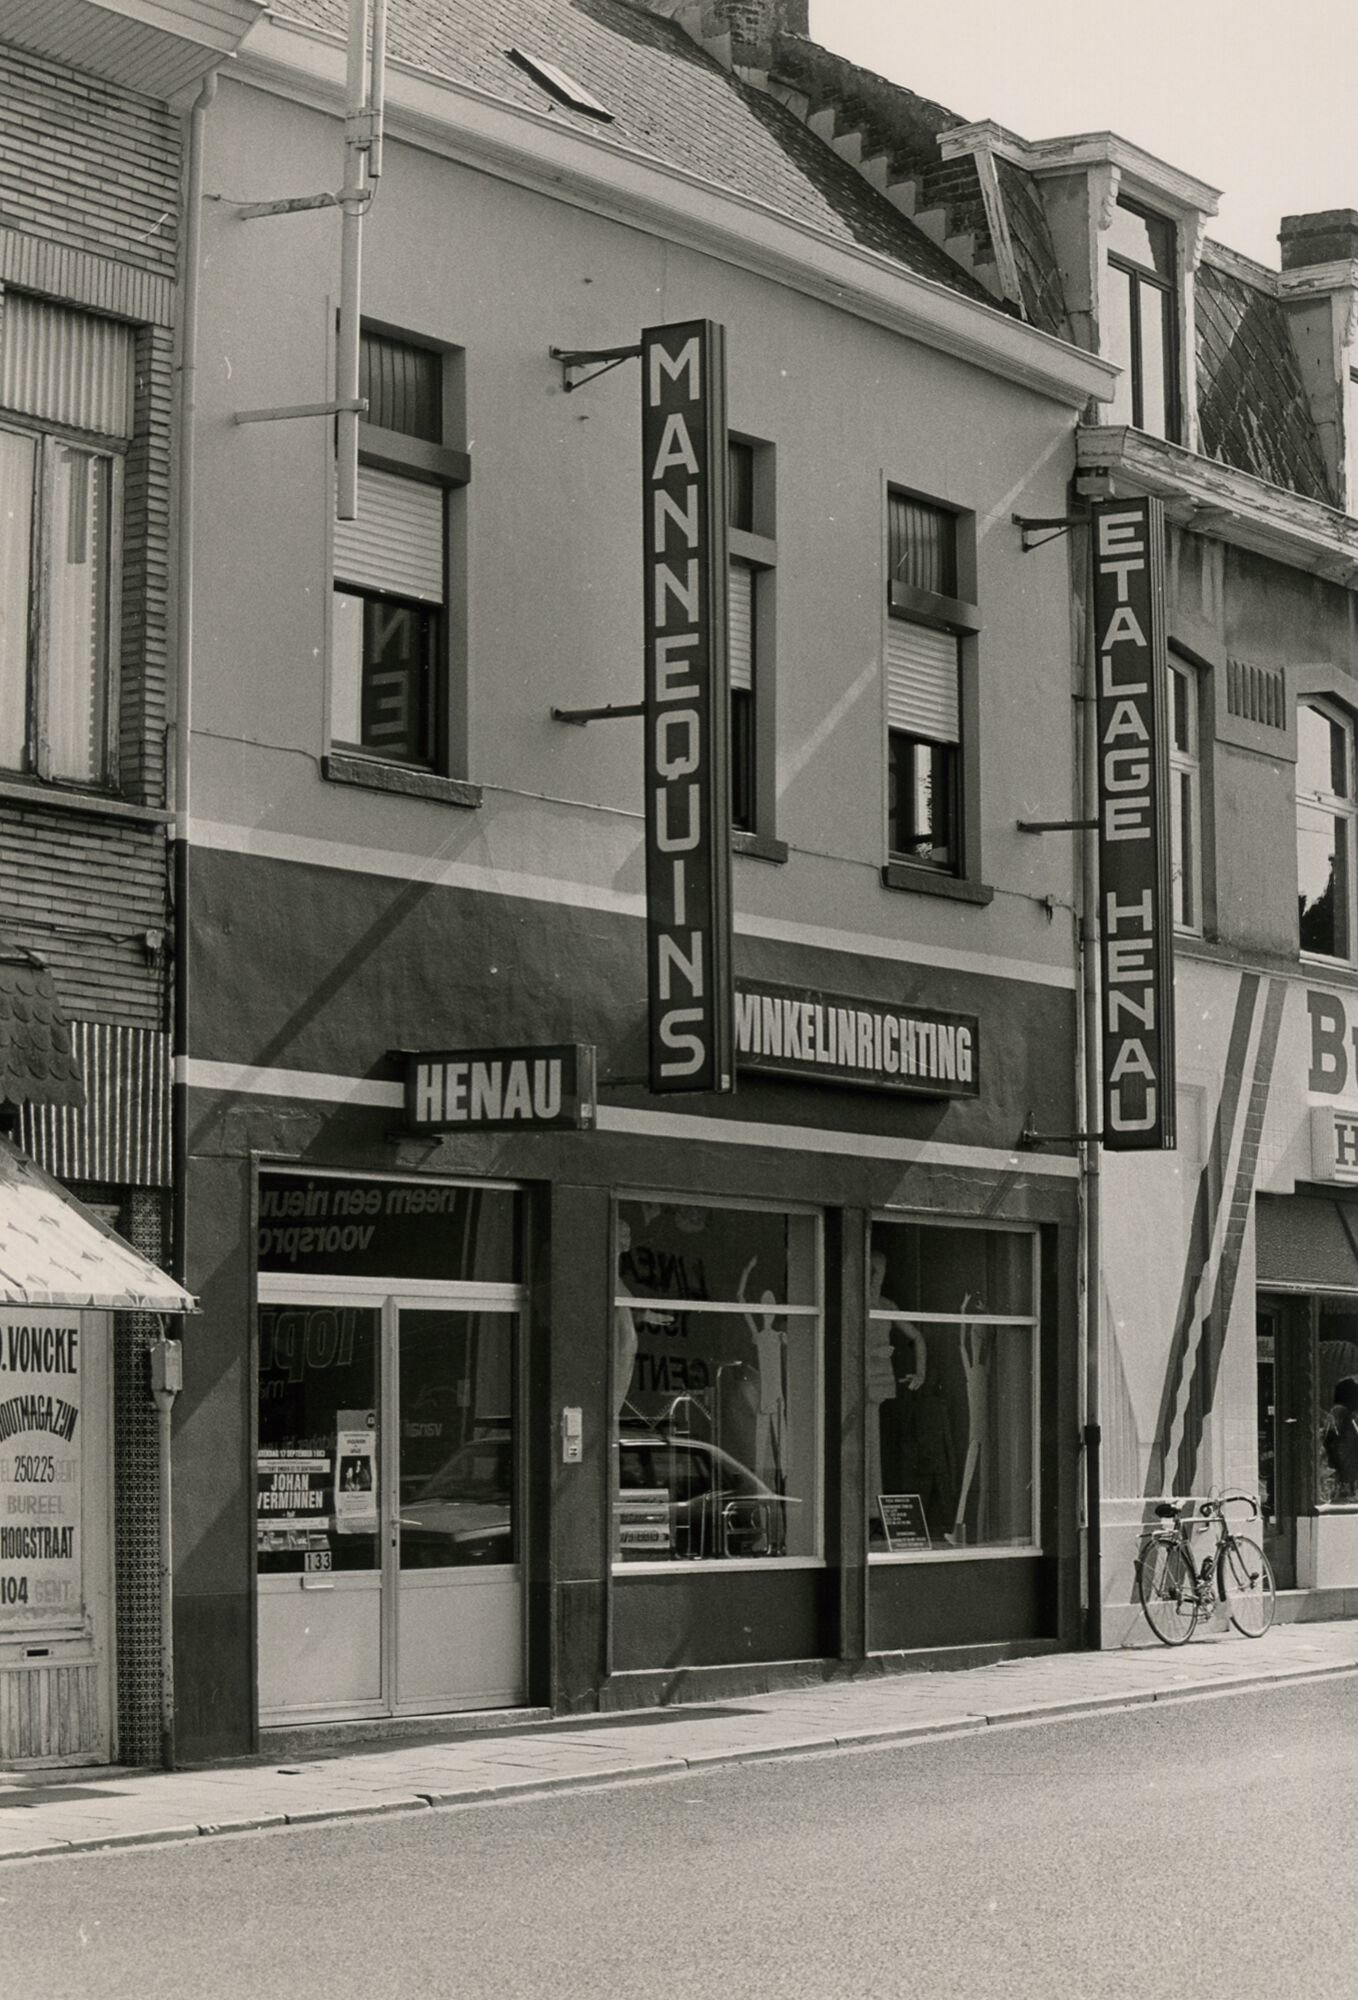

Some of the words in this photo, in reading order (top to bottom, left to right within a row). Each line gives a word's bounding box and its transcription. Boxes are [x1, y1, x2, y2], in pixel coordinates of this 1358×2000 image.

[1099, 511, 1151, 841] ETALAGE
[649, 337, 705, 1077] MANNEQUINS
[1106, 888, 1157, 1132] HENAU
[1307, 989, 1358, 1095] B
[416, 1059, 562, 1122] HENAU
[0, 1326, 78, 1374] .VONCKE
[14, 1455, 55, 1483] 250225
[270, 1473, 309, 1491] JOHAN
[7, 1495, 65, 1514] BUREEL
[0, 1526, 74, 1560] HOOGSTRAAT
[307, 1553, 331, 1570] 133
[1, 1576, 28, 1605] 104
